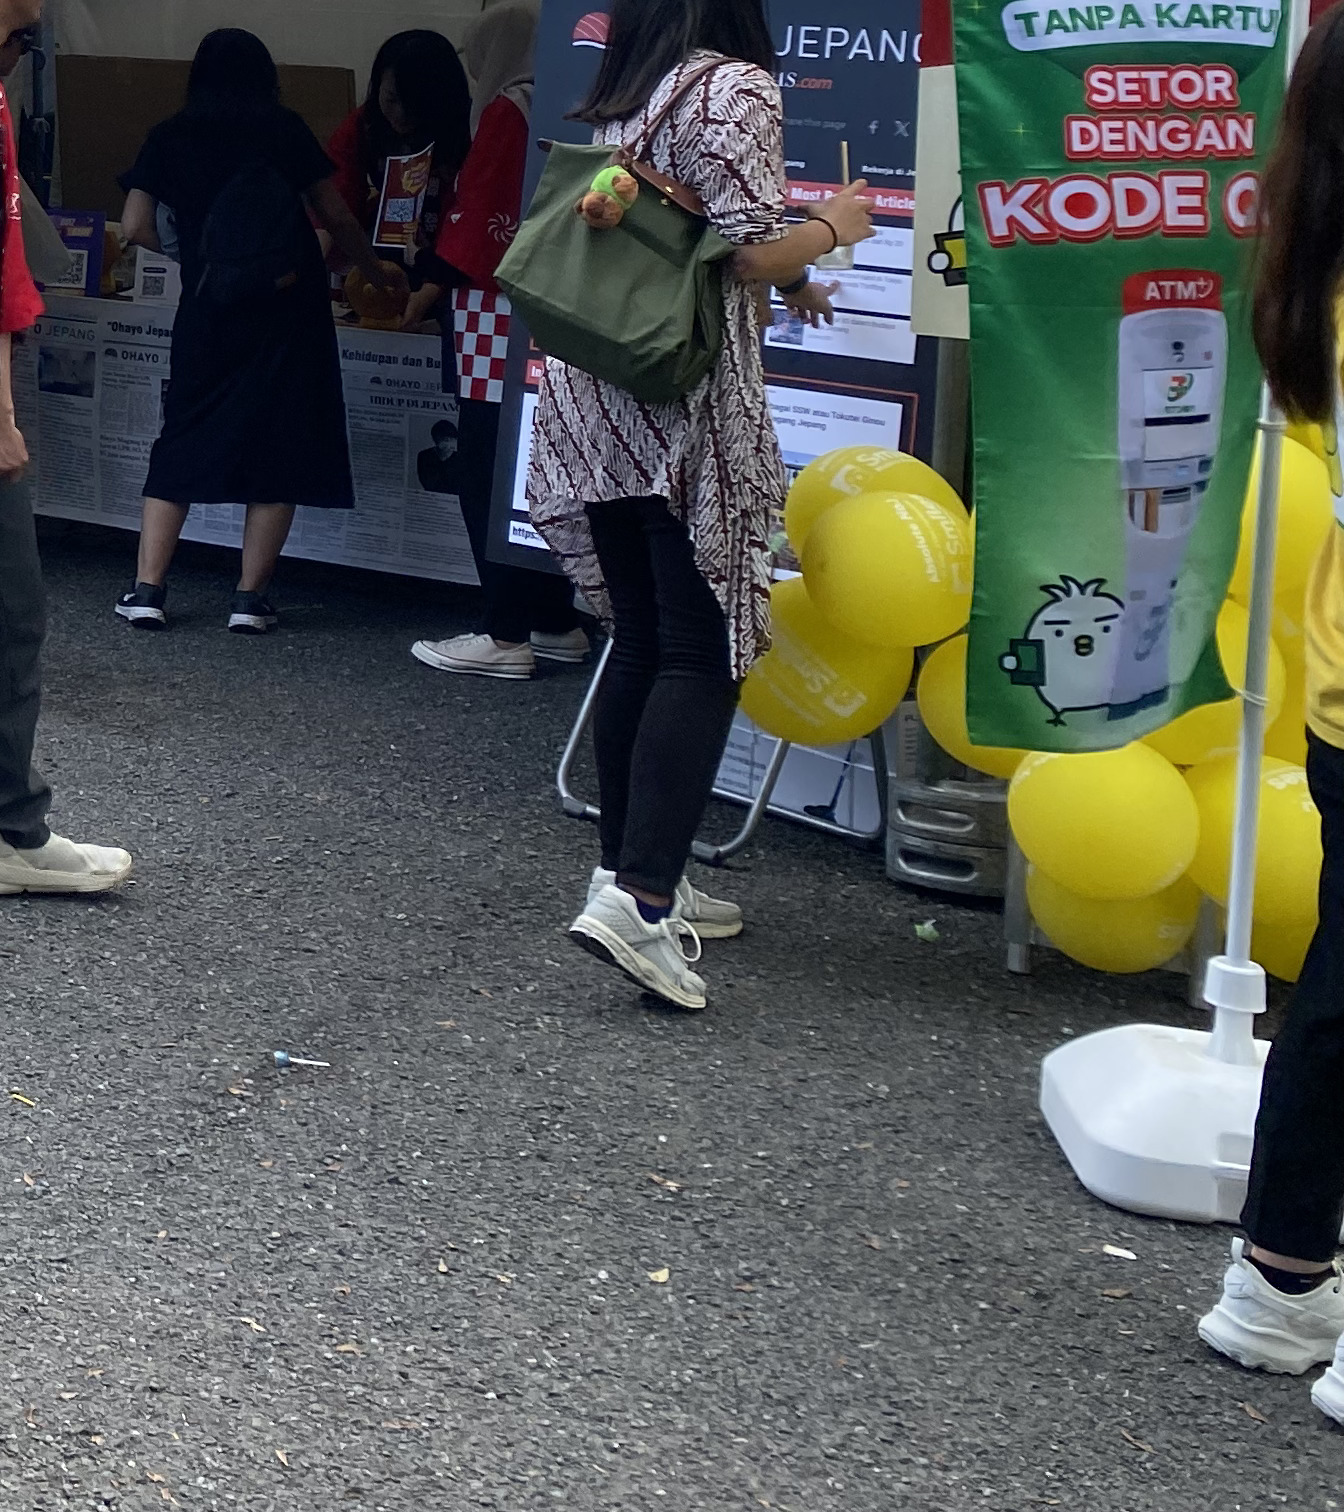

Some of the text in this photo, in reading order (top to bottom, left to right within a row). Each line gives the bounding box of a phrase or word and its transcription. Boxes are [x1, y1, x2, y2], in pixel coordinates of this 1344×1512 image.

[1014, 3, 1280, 38] TANPA KARTU
[1088, 69, 1234, 104] SETOR
[1070, 118, 1254, 154] DENGAN
[791, 187, 821, 201] Most
[983, 175, 1205, 237] KODE
[1144, 280, 1198, 301] ATM
[45, 324, 95, 342] JEPANG
[120, 350, 159, 364] OHAYO
[342, 349, 399, 365] Kehidupan
[402, 355, 423, 367] dan
[385, 378, 421, 390] OHAYO
